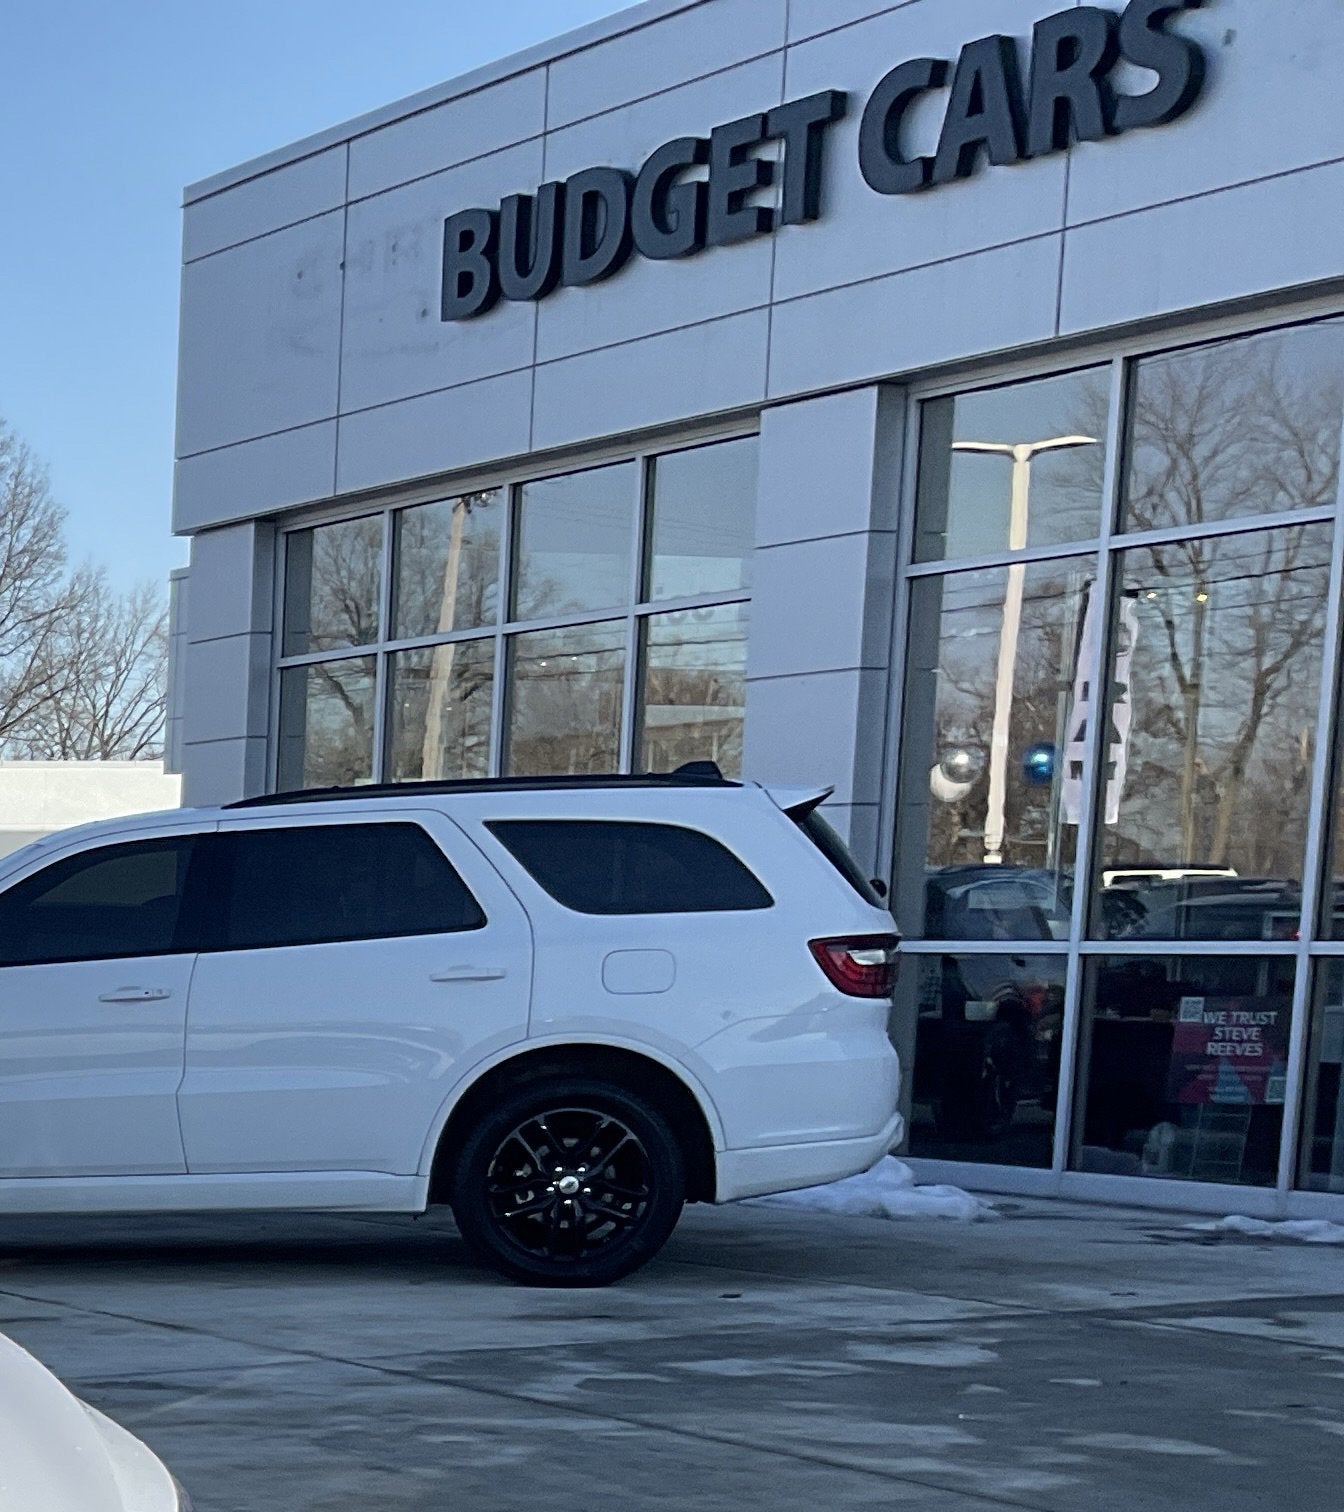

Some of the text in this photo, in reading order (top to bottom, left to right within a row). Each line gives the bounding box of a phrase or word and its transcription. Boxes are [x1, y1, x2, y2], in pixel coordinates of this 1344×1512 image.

[441, 0, 1208, 322] BUDGET CARS
[1203, 1010, 1278, 1025] WE TRUST
[1213, 1026, 1262, 1041] STEVE
[1206, 1042, 1264, 1056] REEVES
